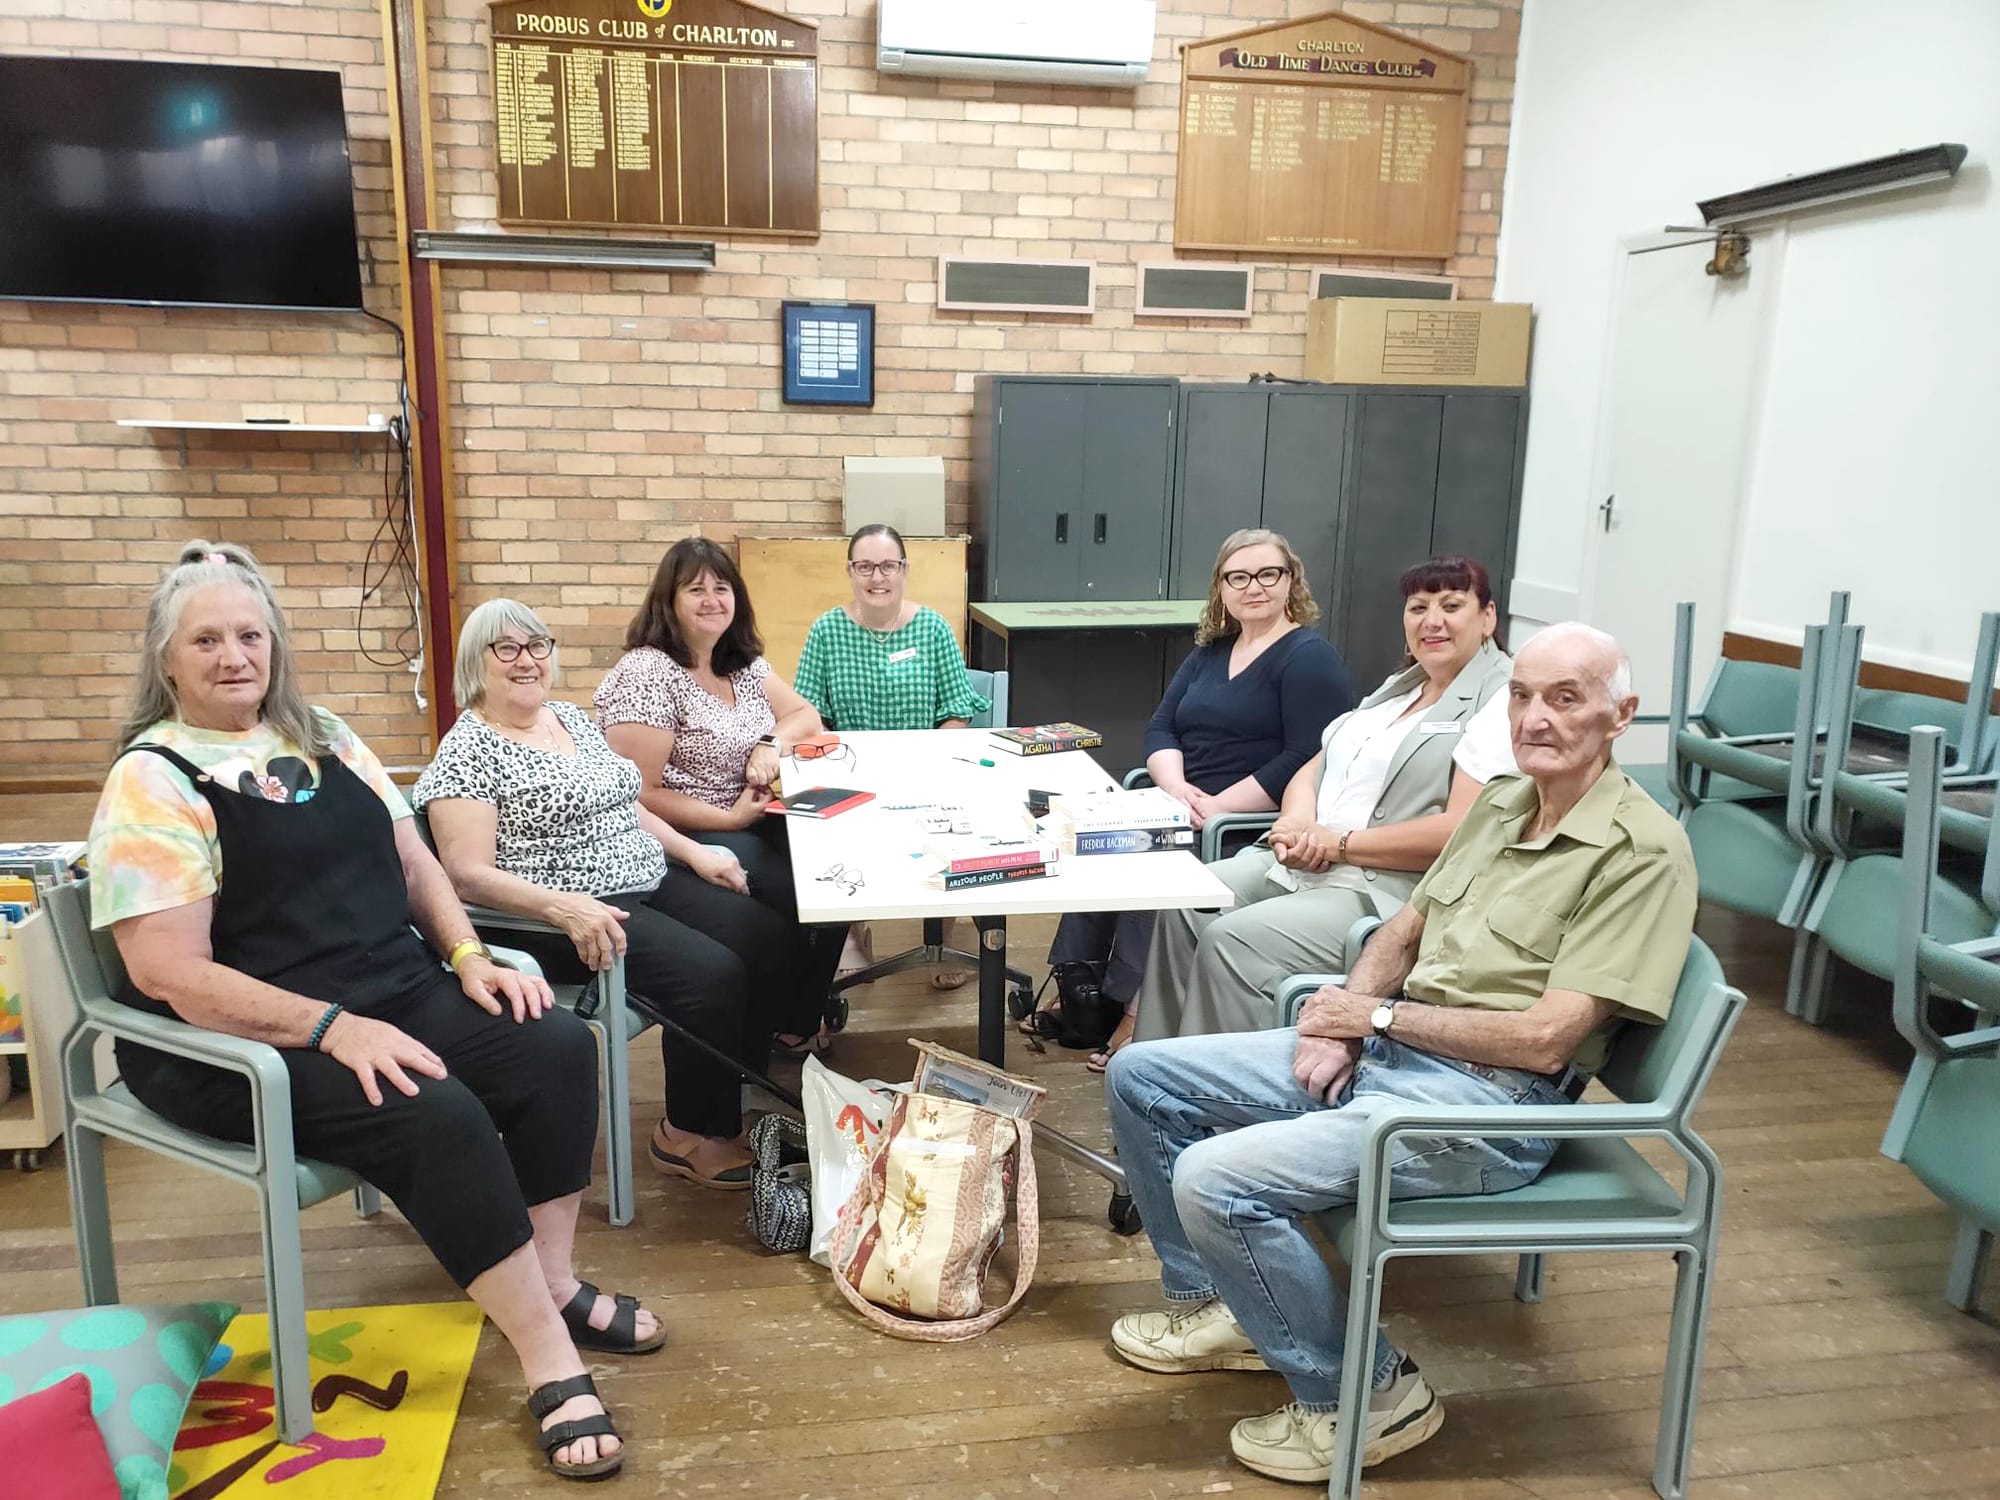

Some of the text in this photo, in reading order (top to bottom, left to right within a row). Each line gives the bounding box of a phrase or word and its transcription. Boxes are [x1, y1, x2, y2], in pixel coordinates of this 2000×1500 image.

[517, 13, 590, 35] PROBUS
[598, 19, 649, 39] CLUB
[654, 23, 666, 39] of
[672, 24, 778, 47] CHARLTON
[1298, 39, 1365, 54] CHARLTON
[1238, 50, 1268, 69] OLD
[1276, 52, 1311, 71] TIME
[1319, 55, 1369, 74] DANCE
[1375, 58, 1413, 76] CLUB
[1024, 743, 1052, 755] AGATHA
[1075, 737, 1103, 748] CHRISTIE
[1081, 838, 1105, 851] FREDRIK
[1106, 836, 1136, 849] BACKMAN
[979, 872, 1004, 883] PEOPLE
